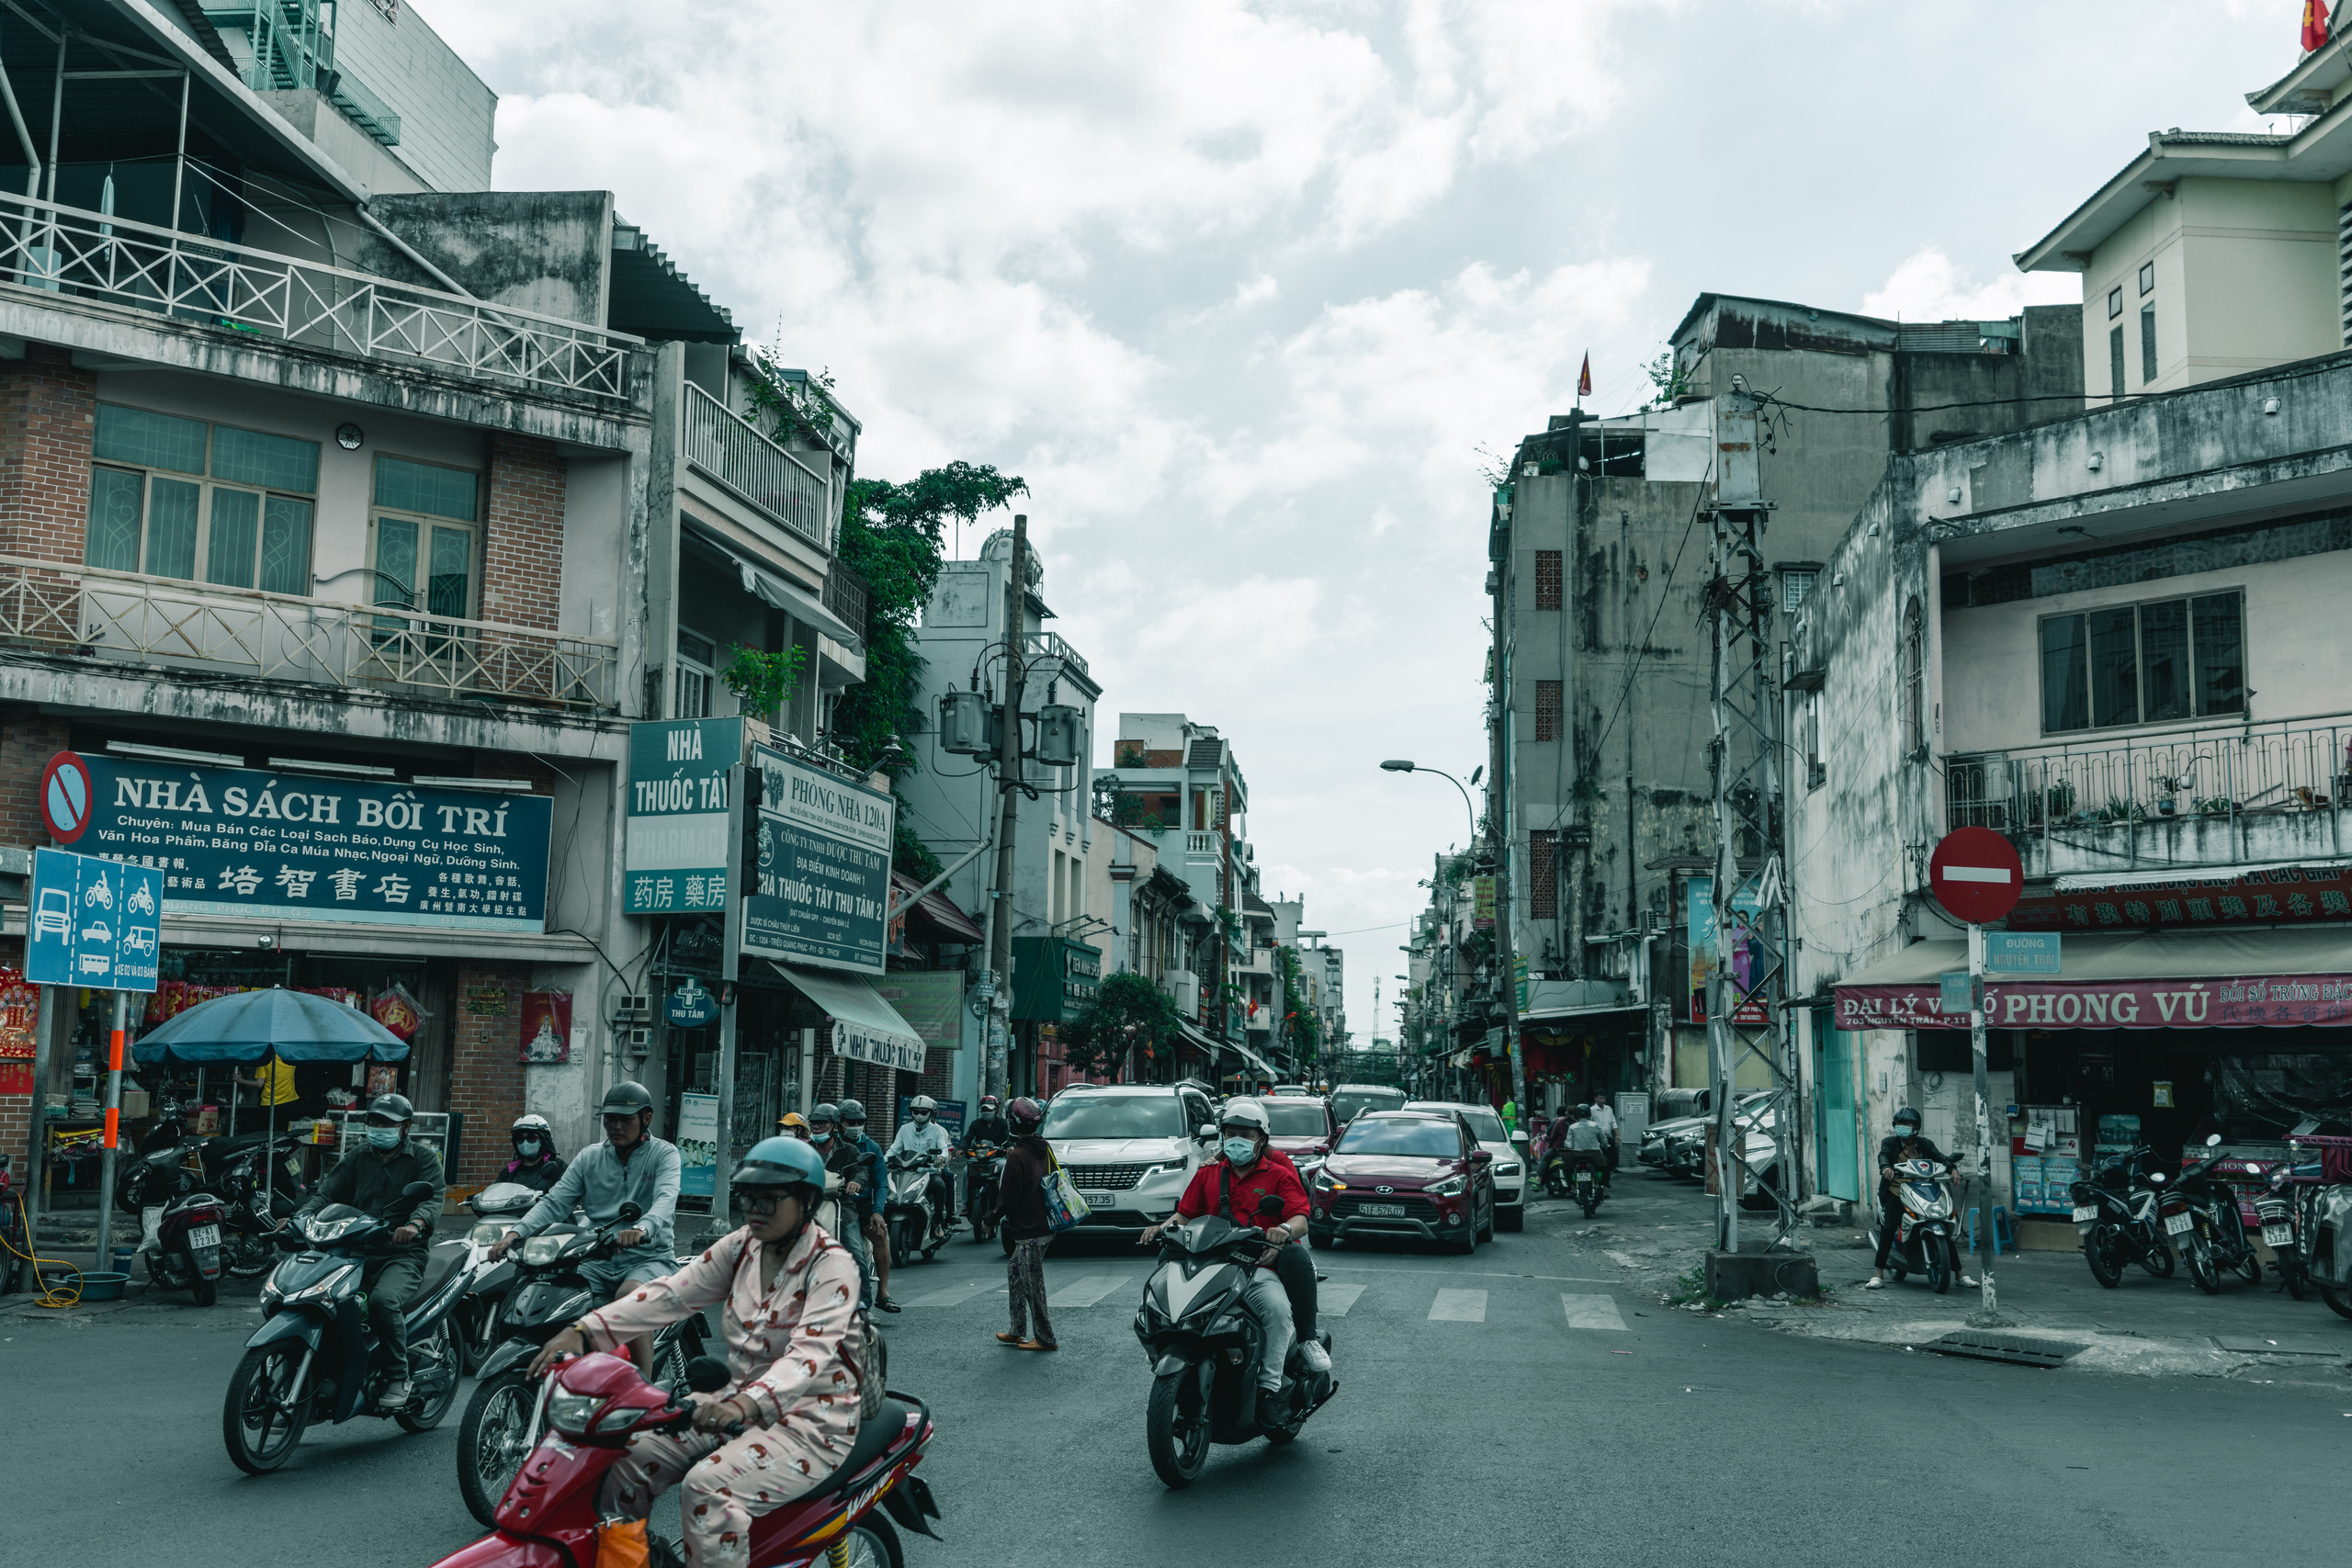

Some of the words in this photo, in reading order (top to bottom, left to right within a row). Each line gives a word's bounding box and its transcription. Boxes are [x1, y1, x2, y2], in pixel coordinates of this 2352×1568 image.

[667, 721, 703, 761] NHÀ
[113, 772, 213, 813] NHÀ
[222, 779, 342, 824] SÁCH
[356, 790, 424, 830] BỒI
[436, 801, 510, 837] TRÍ
[635, 767, 694, 812] THUỐC
[699, 770, 729, 809] TÂY
[791, 776, 834, 813] PHÒNG
[837, 794, 861, 822] NHA
[864, 805, 887, 832] 120A
[98, 829, 125, 841] Văn
[131, 832, 160, 844] Hoa
[165, 834, 209, 849] Phẩm,
[211, 838, 248, 852] Băng
[254, 840, 277, 852] Đĩa
[280, 843, 299, 854] Ca
[302, 845, 330, 856] Múa
[334, 848, 369, 861] Nhạc,
[371, 851, 409, 863] Ngoại
[413, 852, 443, 866] Ngữ,
[447, 855, 486, 869] Dưỡng
[490, 858, 520, 871] Sinh.
[117, 815, 175, 830] Chuyên:
[181, 820, 211, 832] Mua
[216, 823, 244, 835] Bán
[249, 826, 276, 837] Các
[281, 829, 310, 842] Loại
[352, 834, 381, 847] Báo,
[383, 836, 416, 851] Dụng
[422, 839, 439, 851] Cụ
[444, 840, 469, 853] Học
[474, 843, 504, 855] Sinh,
[633, 828, 728, 862] PHARMAC
[781, 829, 799, 846] CÔNG
[800, 837, 808, 848] TY
[808, 840, 825, 854] TNHH
[827, 841, 848, 863] DƯỢC
[849, 849, 864, 865] THU
[865, 851, 880, 871] TÂM
[218, 864, 412, 904] 培智書店
[797, 856, 808, 872] ĐỊA
[808, 856, 824, 875] ĐIỂM
[825, 864, 840, 879] KINH
[841, 869, 861, 885] DOANH
[862, 874, 865, 886] 1
[634, 875, 674, 908] 药房
[778, 876, 812, 905] THUỐC
[815, 884, 833, 909] TÂY
[835, 891, 854, 914] THU
[855, 894, 875, 919] TÂM
[876, 902, 882, 921] 2
[1994, 950, 2030, 965] NGUYỄN
[2033, 952, 2054, 965] TRÃI
[2006, 937, 2044, 948] ĐƯỜNG
[123, 964, 130, 976] 02
[130, 962, 137, 977] VÀ
[137, 966, 143, 977] 03
[143, 964, 157, 978] BÁNH
[1843, 998, 1883, 1019] ĐẠI
[1889, 993, 1919, 1014] LÝ
[1926, 998, 1942, 1014] V
[1984, 988, 1998, 1014] Ố
[2004, 992, 2140, 1023] PHONG
[2153, 983, 2211, 1022] VŨ
[2220, 977, 2245, 1002] ĐỔI
[2248, 978, 2267, 1002] SỐ
[2270, 980, 2319, 1001] TRÚNG
[2323, 979, 2352, 1004] ĐẶC
[672, 1010, 686, 1018] THU
[687, 1009, 705, 1019] TÂM
[1867, 1014, 1907, 1025] NGUYỄN
[1909, 1015, 1934, 1024] TRÃI
[850, 1032, 867, 1059] NHÀ
[869, 1036, 896, 1065] THUỐC
[193, 1227, 214, 1238] 82-K1
[195, 1235, 216, 1247] 2236
[2171, 1223, 2189, 1233] 6189
